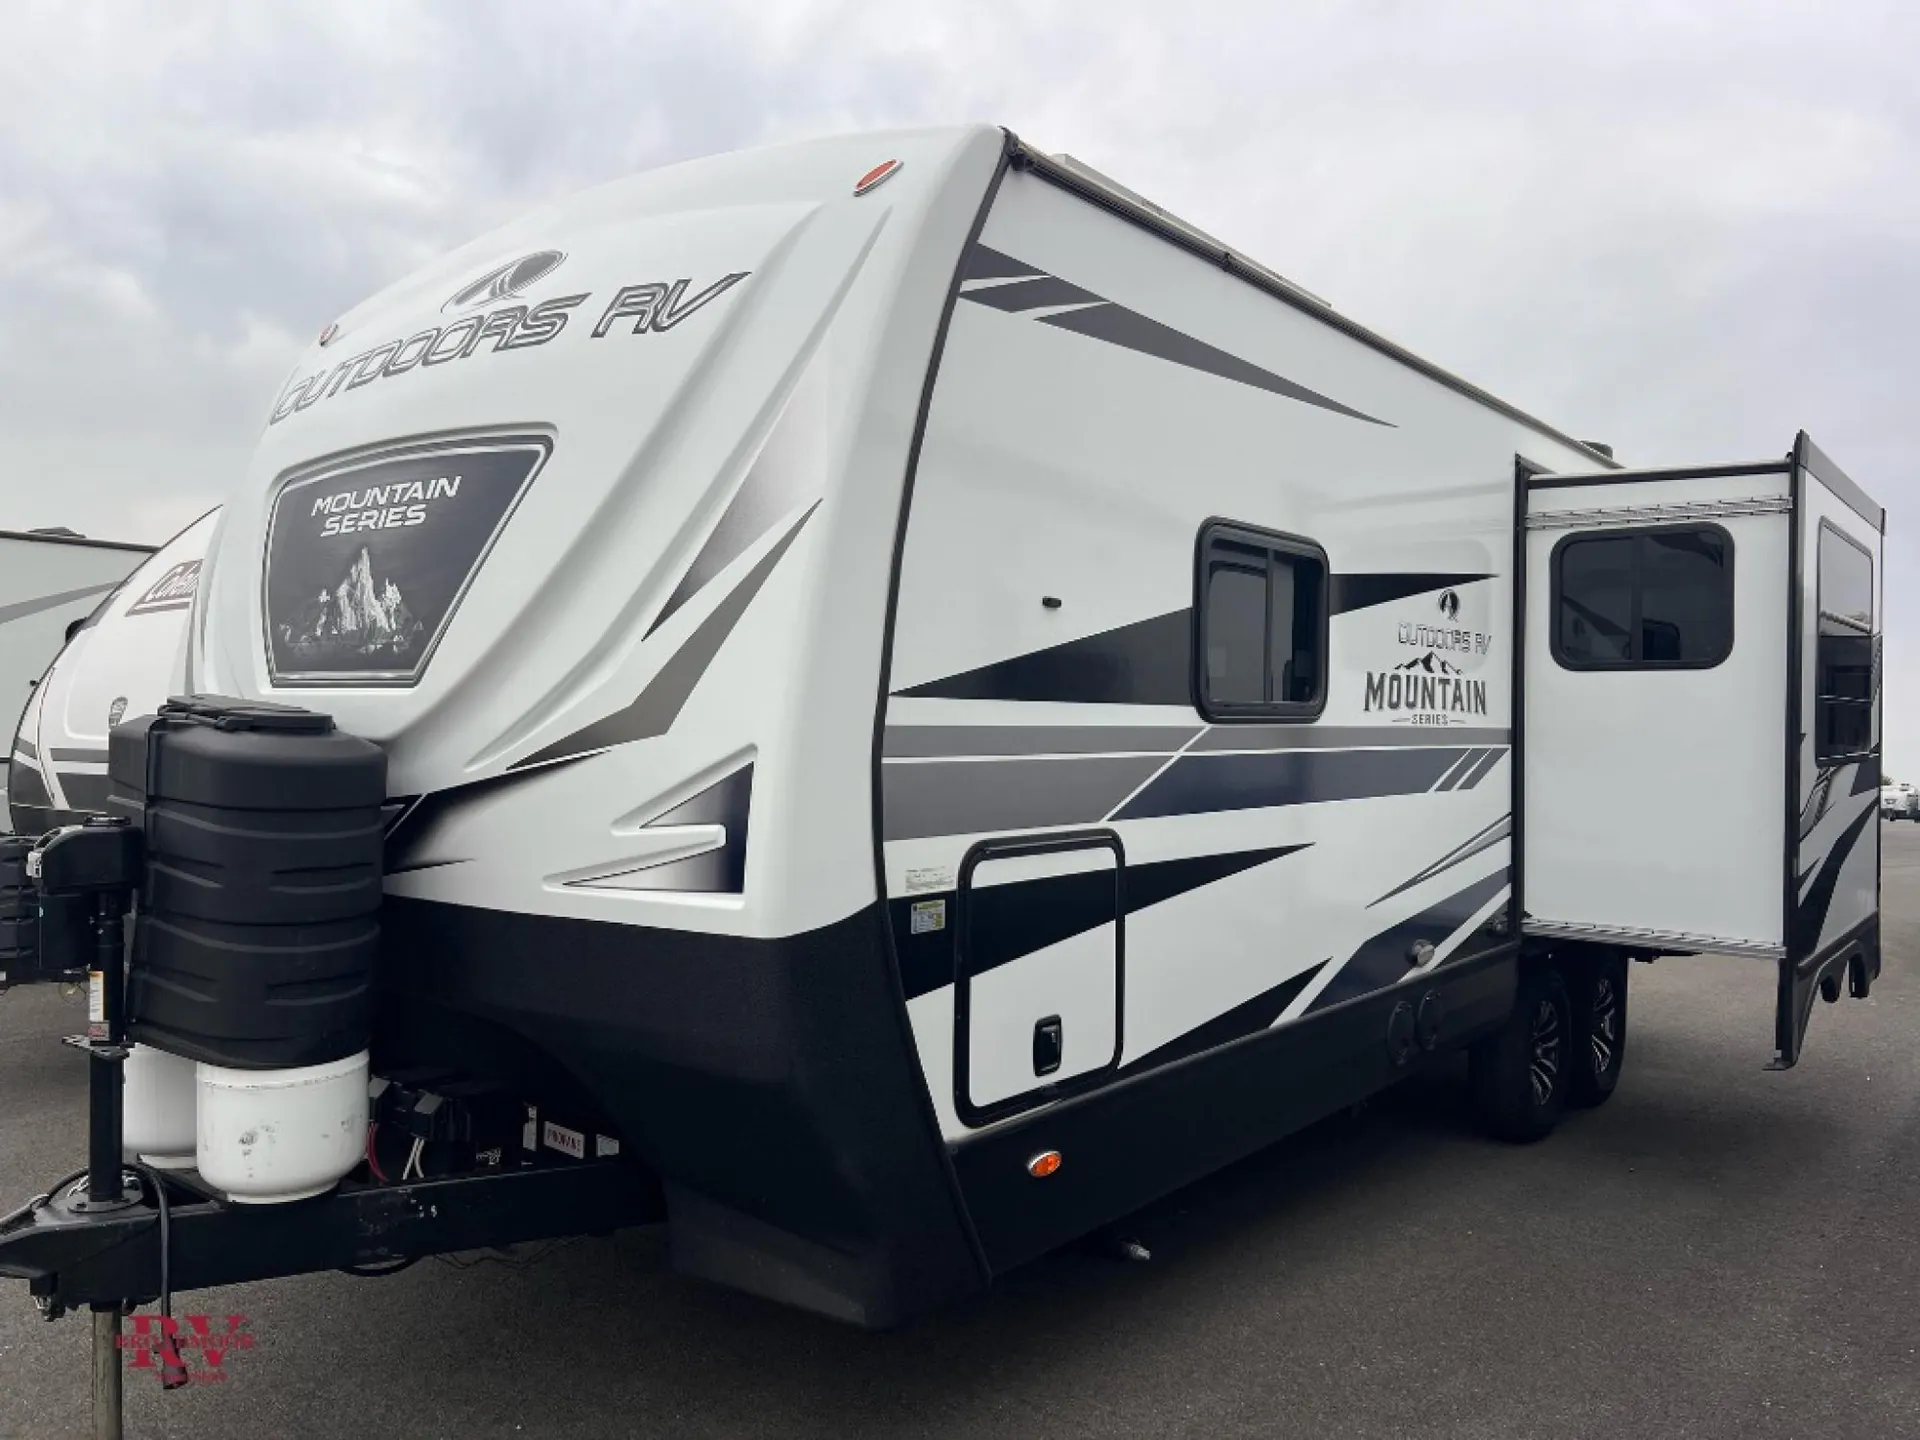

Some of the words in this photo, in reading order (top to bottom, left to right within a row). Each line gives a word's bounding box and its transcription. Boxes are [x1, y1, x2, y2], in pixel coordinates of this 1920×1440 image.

[269, 292, 592, 425] OUTDOORS
[591, 271, 752, 337] RV
[311, 475, 462, 516] MOUNTAIN
[320, 503, 427, 537] SERIES
[1398, 622, 1471, 653] OUTDOORS
[1475, 632, 1493, 655] RV
[1364, 671, 1487, 715] MOUNTAIN
[1411, 714, 1449, 726] SERIES
